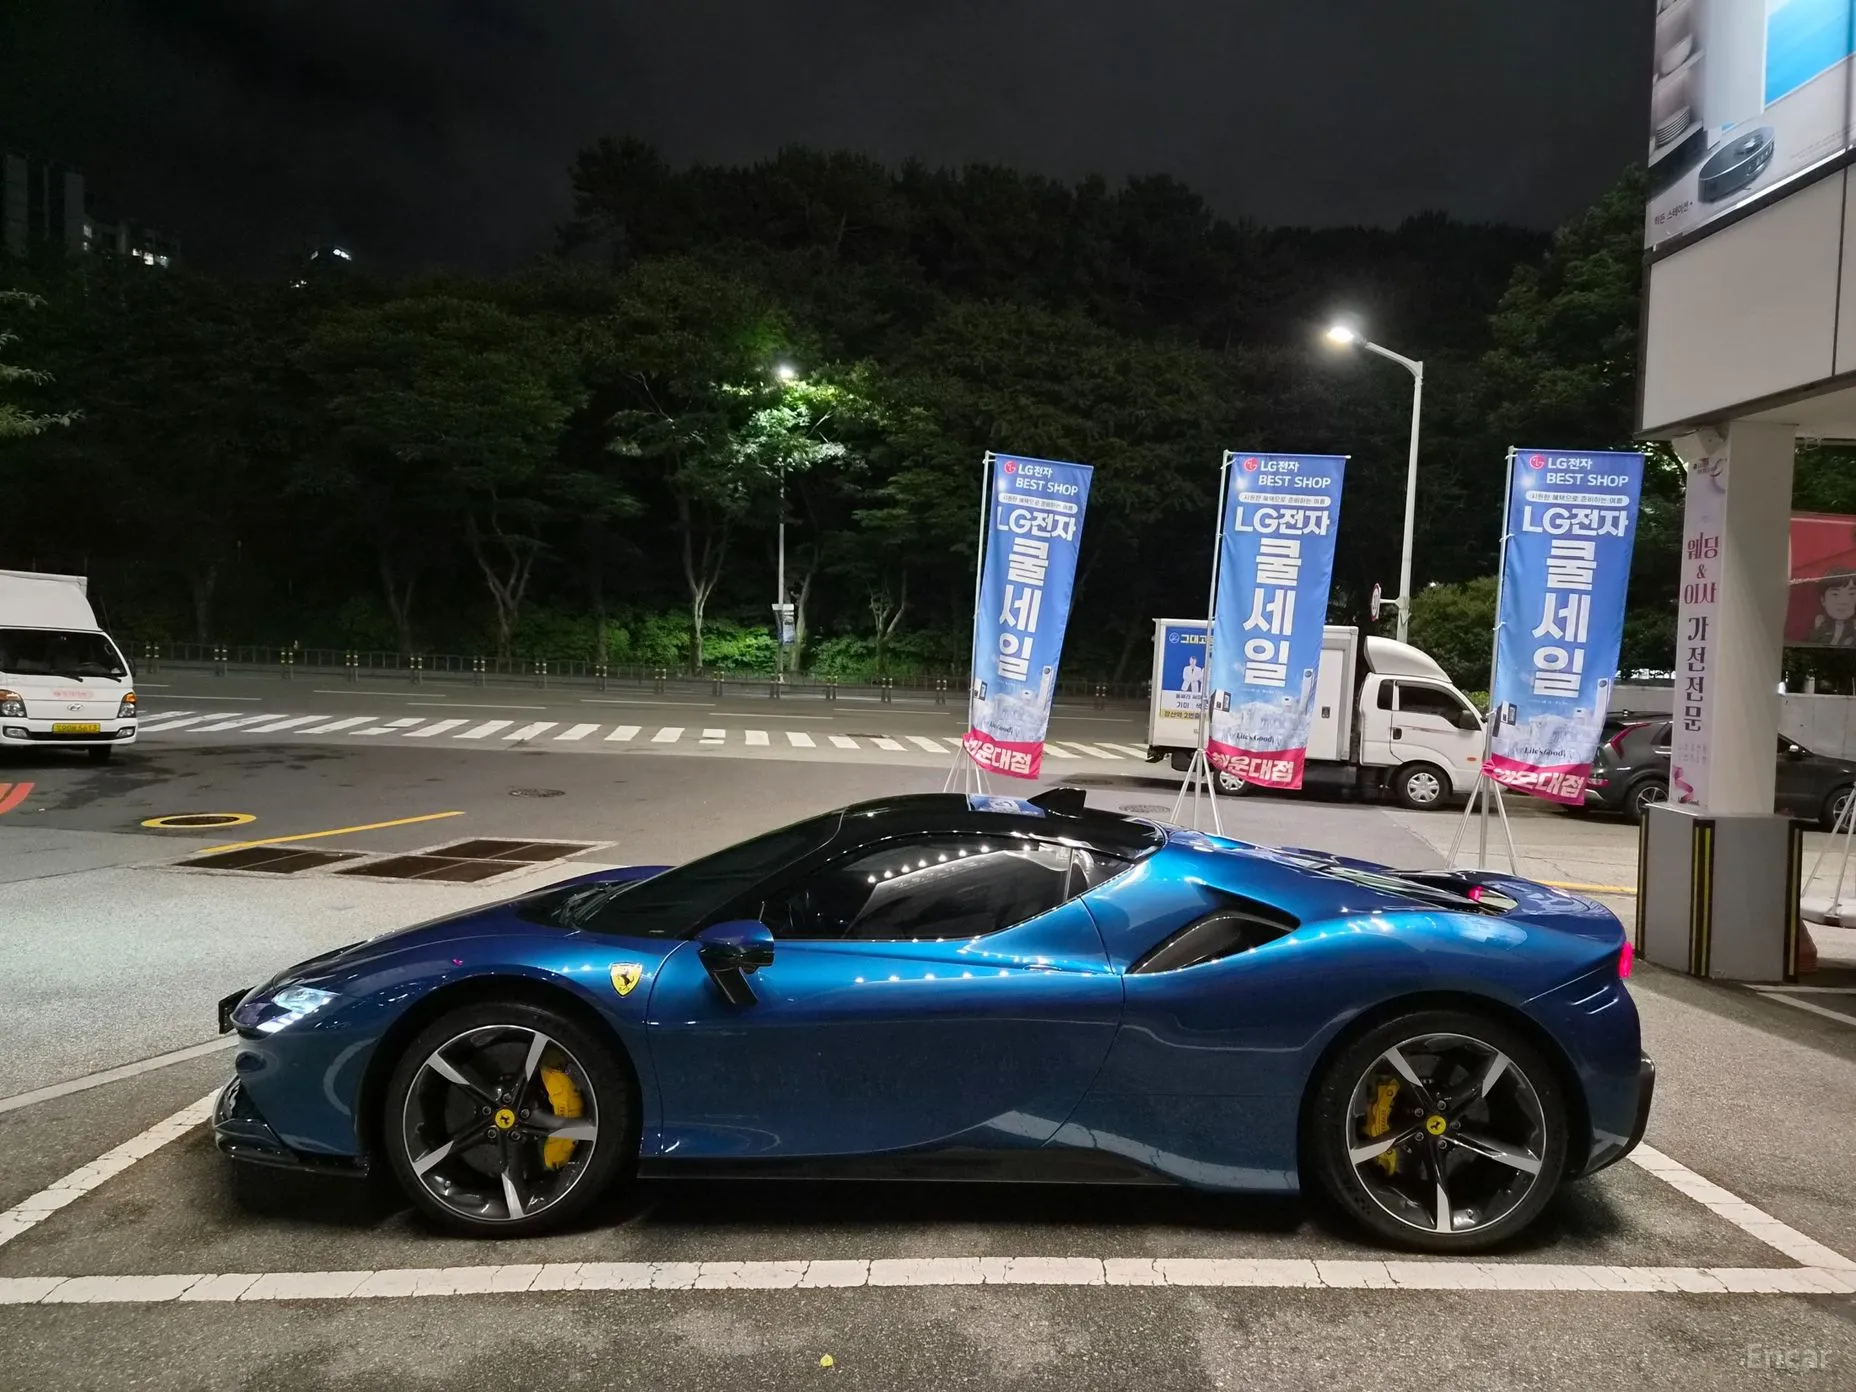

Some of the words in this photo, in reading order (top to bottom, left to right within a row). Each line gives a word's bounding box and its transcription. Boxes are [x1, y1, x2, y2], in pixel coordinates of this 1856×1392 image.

[1018, 464, 1053, 478] LG전자
[1261, 460, 1299, 472] LG전자
[1548, 457, 1593, 470] LG전자
[1016, 478, 1045, 491] BEST
[1047, 482, 1078, 496] SHOP
[1258, 475, 1291, 486] BEST
[1294, 477, 1331, 488] SHOP
[1546, 473, 1584, 485] BEST
[1587, 474, 1629, 487] SHOP
[997, 506, 1076, 541] LG전자
[1235, 506, 1330, 536] LG전자
[1522, 505, 1629, 537] LG전자
[1687, 532, 1720, 560] 웨딩
[1696, 563, 1707, 579] &
[1684, 582, 1717, 605] 이사
